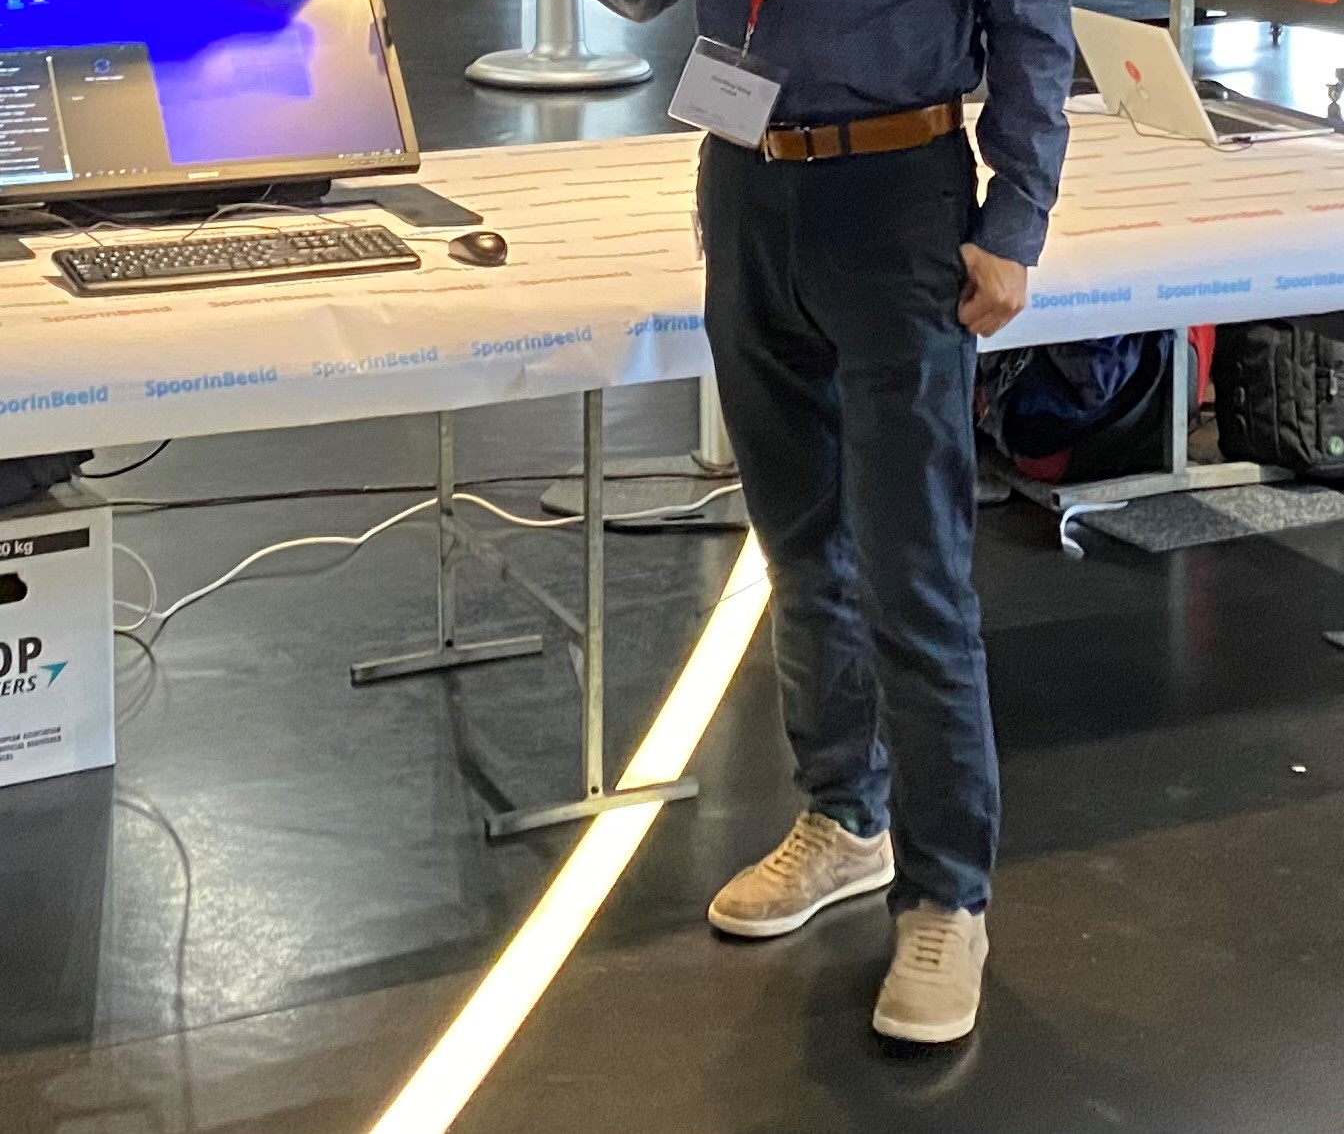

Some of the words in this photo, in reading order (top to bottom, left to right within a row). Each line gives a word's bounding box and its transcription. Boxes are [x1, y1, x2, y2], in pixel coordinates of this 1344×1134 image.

[144, 365, 279, 399] SpoorInBeeld
[311, 344, 440, 377] SpoorInBeeld
[470, 325, 593, 358] SpoorInBeeld
[1031, 286, 1132, 309] SpoorInBeeld
[1156, 277, 1252, 300] SpoorInBeeld
[13, 539, 34, 558] kg
